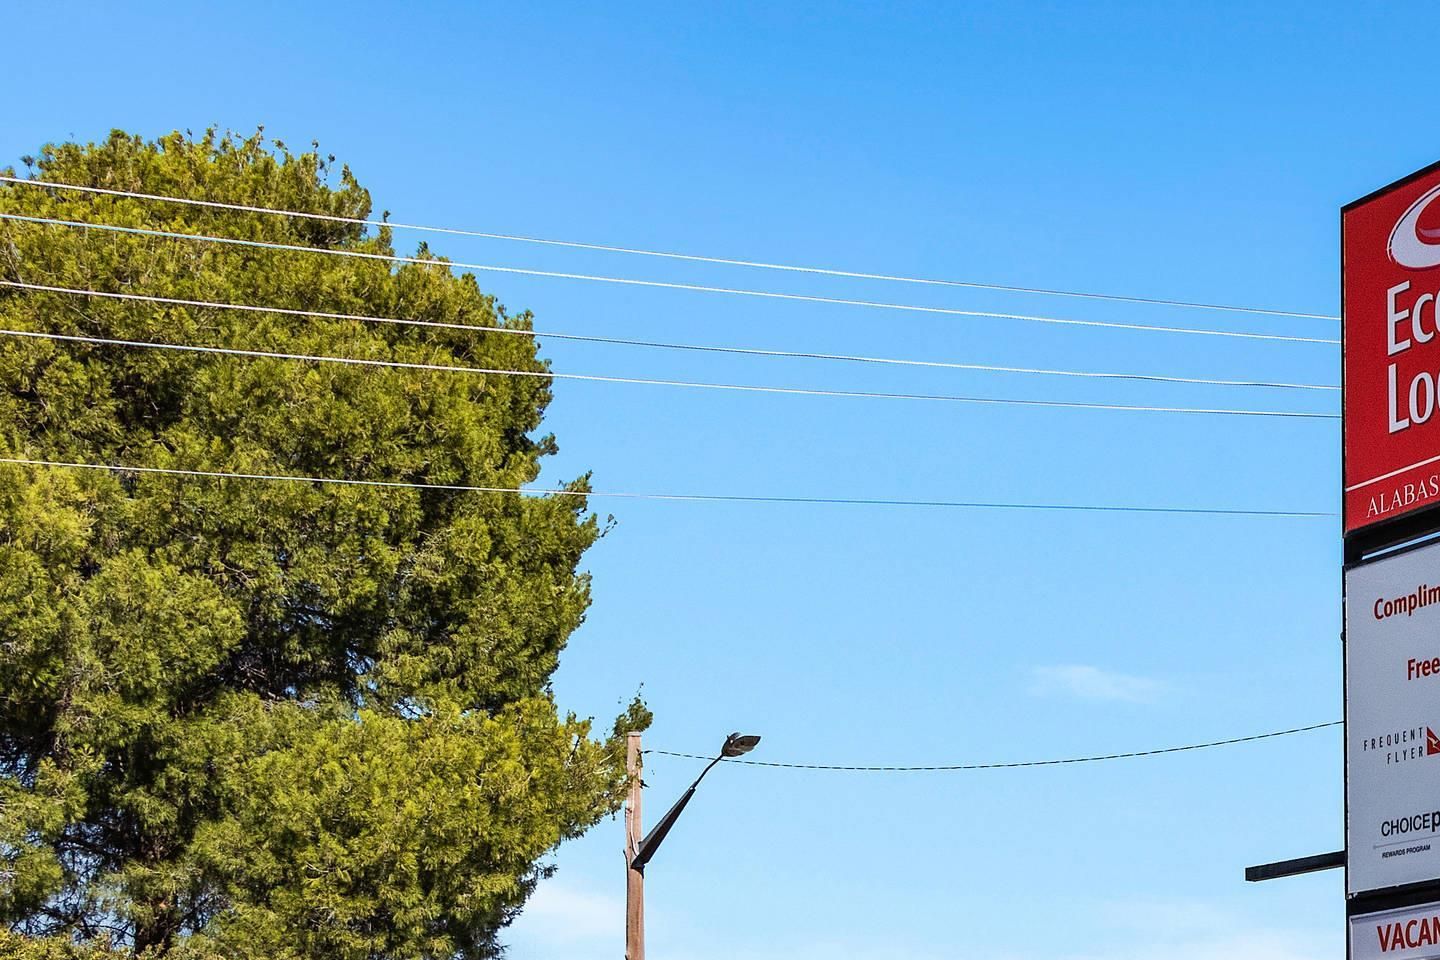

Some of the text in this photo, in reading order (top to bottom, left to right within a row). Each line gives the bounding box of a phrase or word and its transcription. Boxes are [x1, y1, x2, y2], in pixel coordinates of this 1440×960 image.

[1407, 658, 1440, 681] Free
[1363, 726, 1424, 751] FREQUENT
[1386, 747, 1424, 765] FLYER
[1381, 844, 1431, 859] REWARDS PROGRAM
